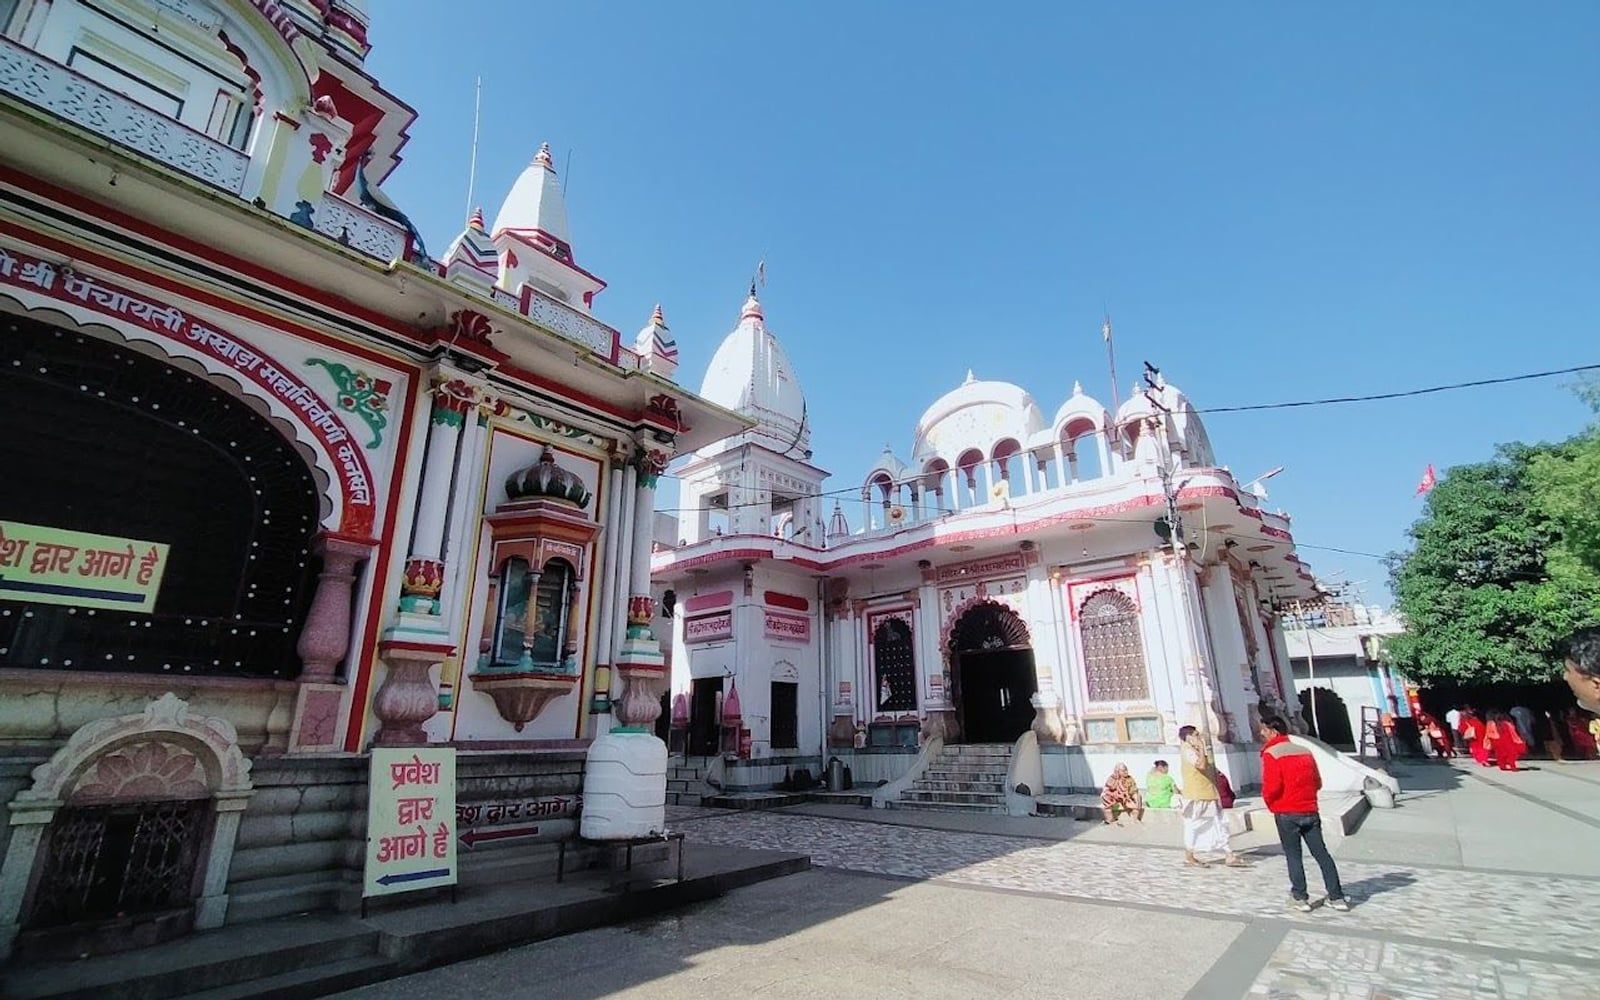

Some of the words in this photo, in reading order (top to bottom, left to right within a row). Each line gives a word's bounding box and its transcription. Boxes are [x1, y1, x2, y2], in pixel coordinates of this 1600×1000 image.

[18, 261, 57, 290] श्री
[63, 273, 186, 333] पंचायती
[184, 322, 263, 371] अखाड़ा
[259, 362, 347, 445] महानिर्वाणी
[337, 442, 371, 506] कनखल
[30, 542, 79, 575] द्वार
[78, 543, 135, 580] आगे
[136, 545, 159, 586] है
[390, 754, 441, 791] प्रवेश
[397, 797, 434, 826] द्वार
[486, 802, 523, 823] द्वार
[526, 797, 571, 817] आगे
[376, 825, 428, 863] आगे
[433, 822, 450, 859] है
